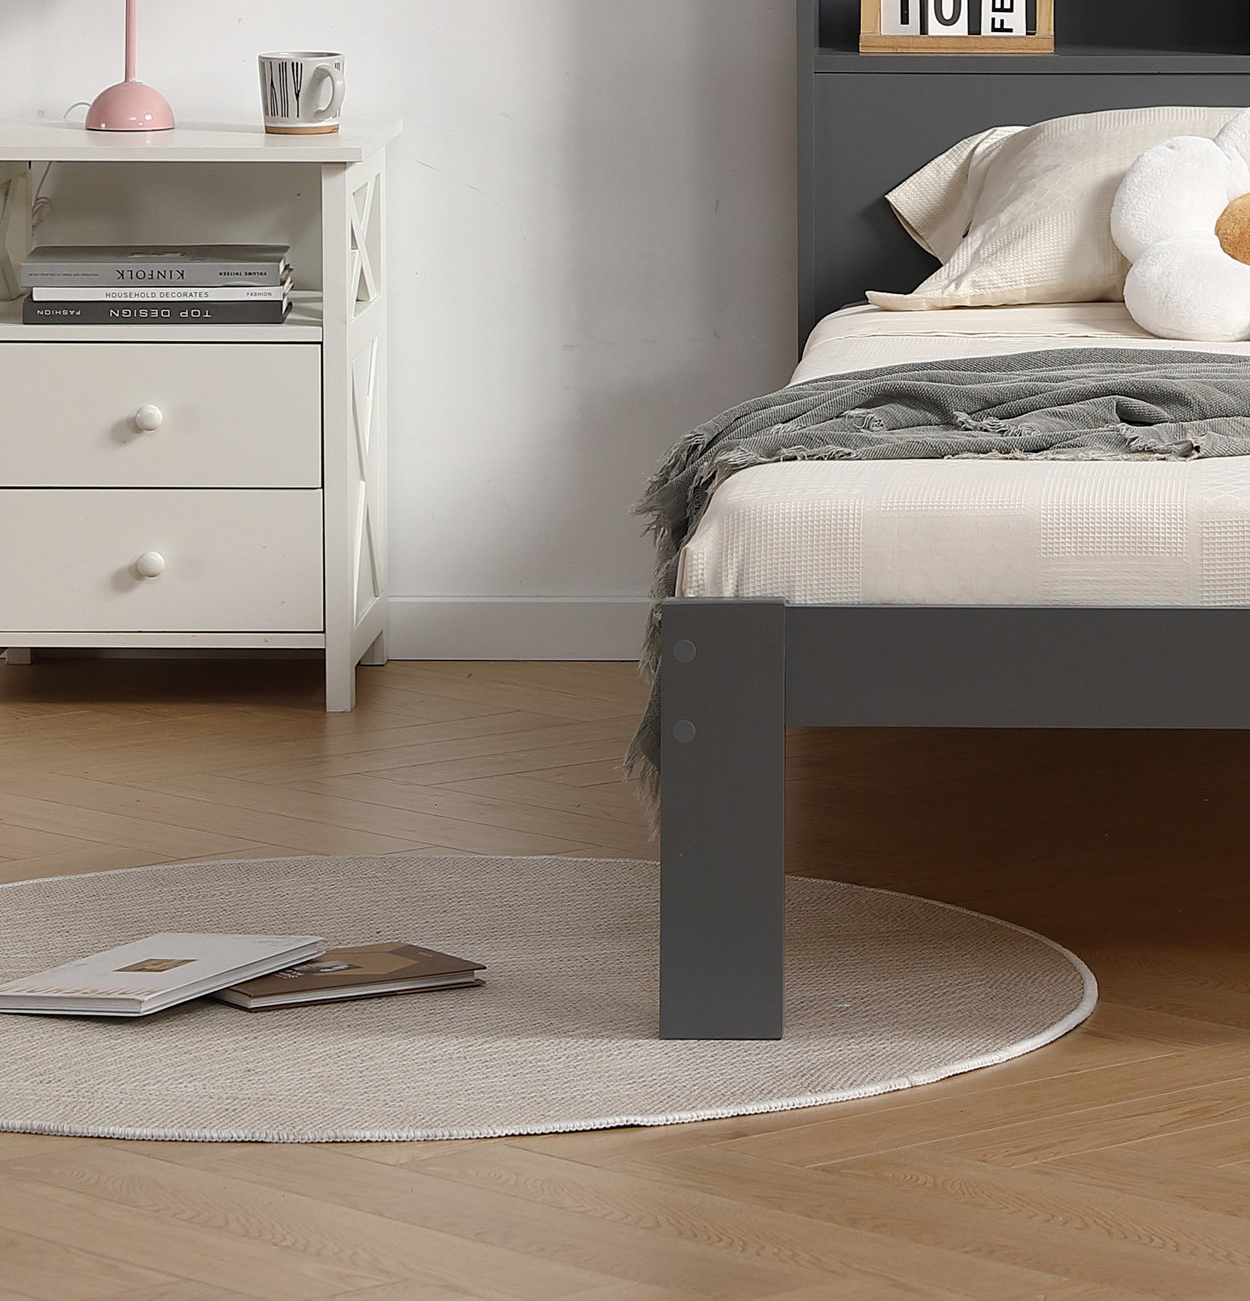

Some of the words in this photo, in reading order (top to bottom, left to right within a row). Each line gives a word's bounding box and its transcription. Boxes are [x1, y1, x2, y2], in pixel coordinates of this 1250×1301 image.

[116, 269, 185, 280] KINFOLK
[109, 309, 171, 318] DESIGN
[180, 309, 212, 318] TOP
